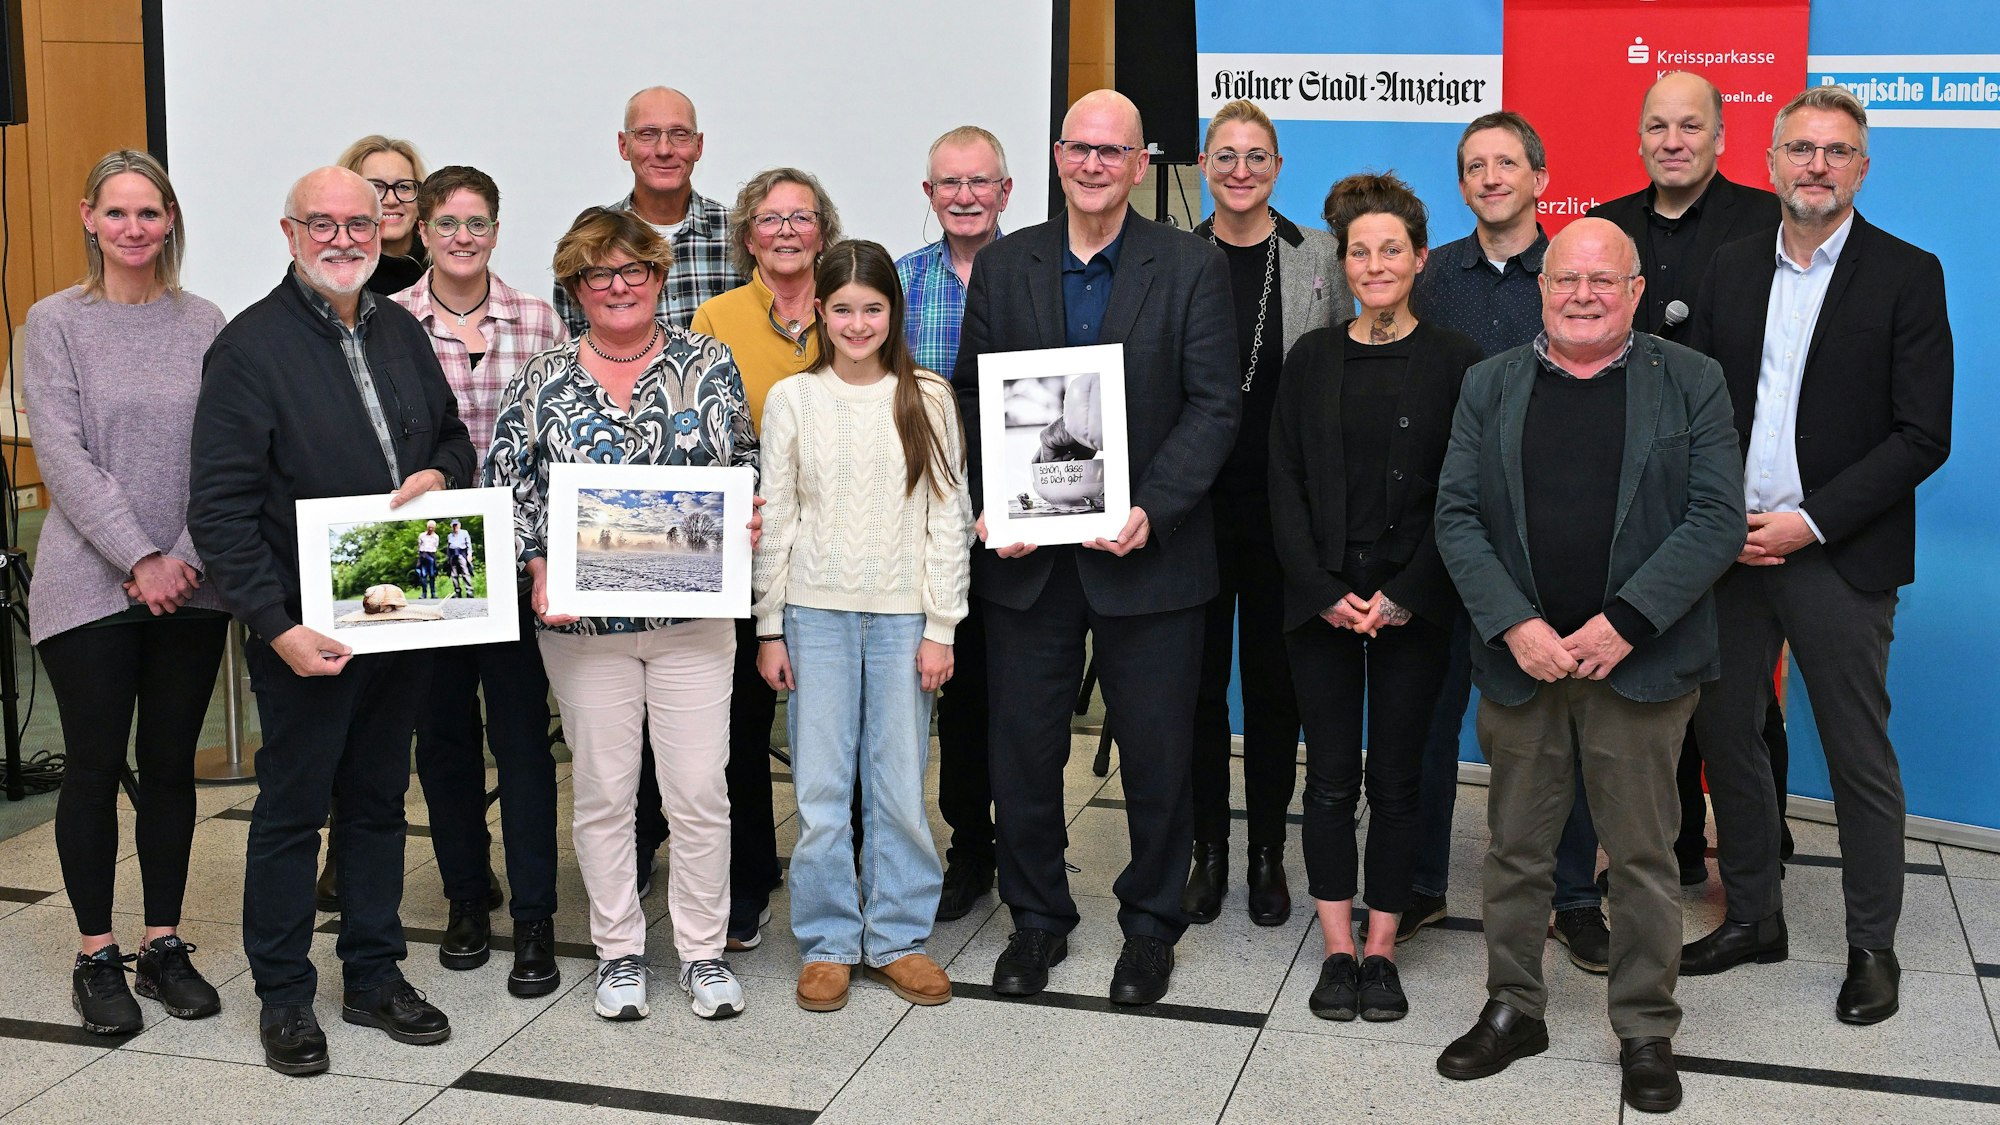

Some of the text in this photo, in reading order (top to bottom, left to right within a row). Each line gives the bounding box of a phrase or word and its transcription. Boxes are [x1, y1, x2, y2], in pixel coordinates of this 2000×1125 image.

[1656, 49, 1776, 67] Kreissparkasse
[1211, 69, 1294, 101] Kölner
[1821, 75, 2000, 107] rgische Lande
[1537, 196, 1601, 215] erzlich
[1064, 464, 1083, 473] dass
